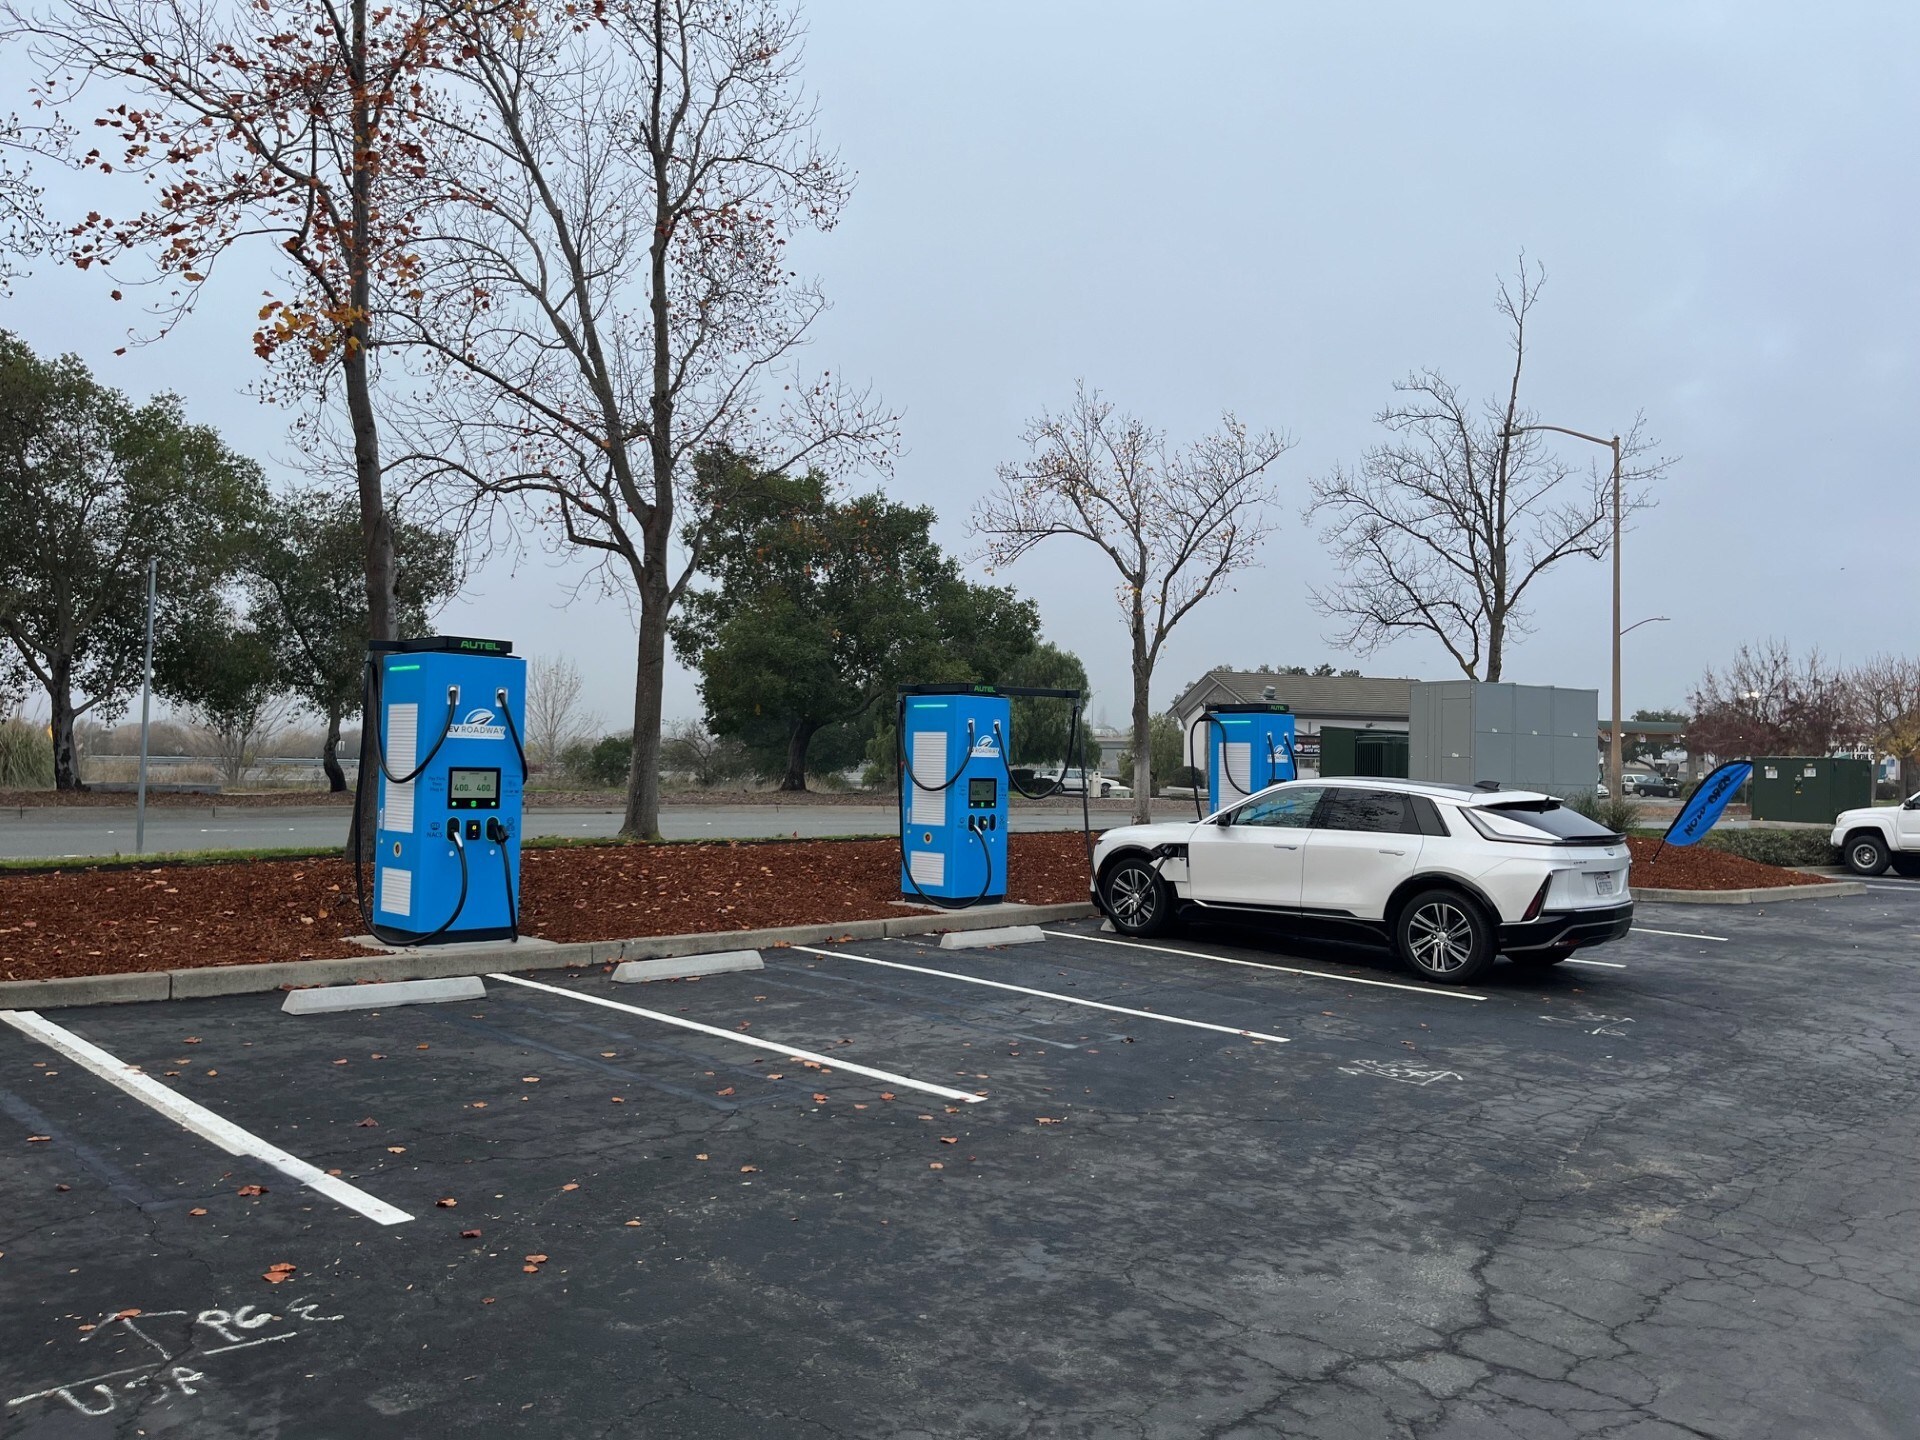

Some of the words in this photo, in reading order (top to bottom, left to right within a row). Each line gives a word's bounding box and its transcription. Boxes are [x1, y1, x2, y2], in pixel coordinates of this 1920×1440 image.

[460, 640, 501, 651] AUTEL
[973, 685, 996, 693] AUTEL
[448, 725, 460, 733] EV
[461, 726, 505, 735] ROADWAY
[453, 784, 469, 792] 400
[476, 784, 491, 792] 400
[1707, 774, 1732, 804] OPEN
[426, 831, 443, 839] NACS
